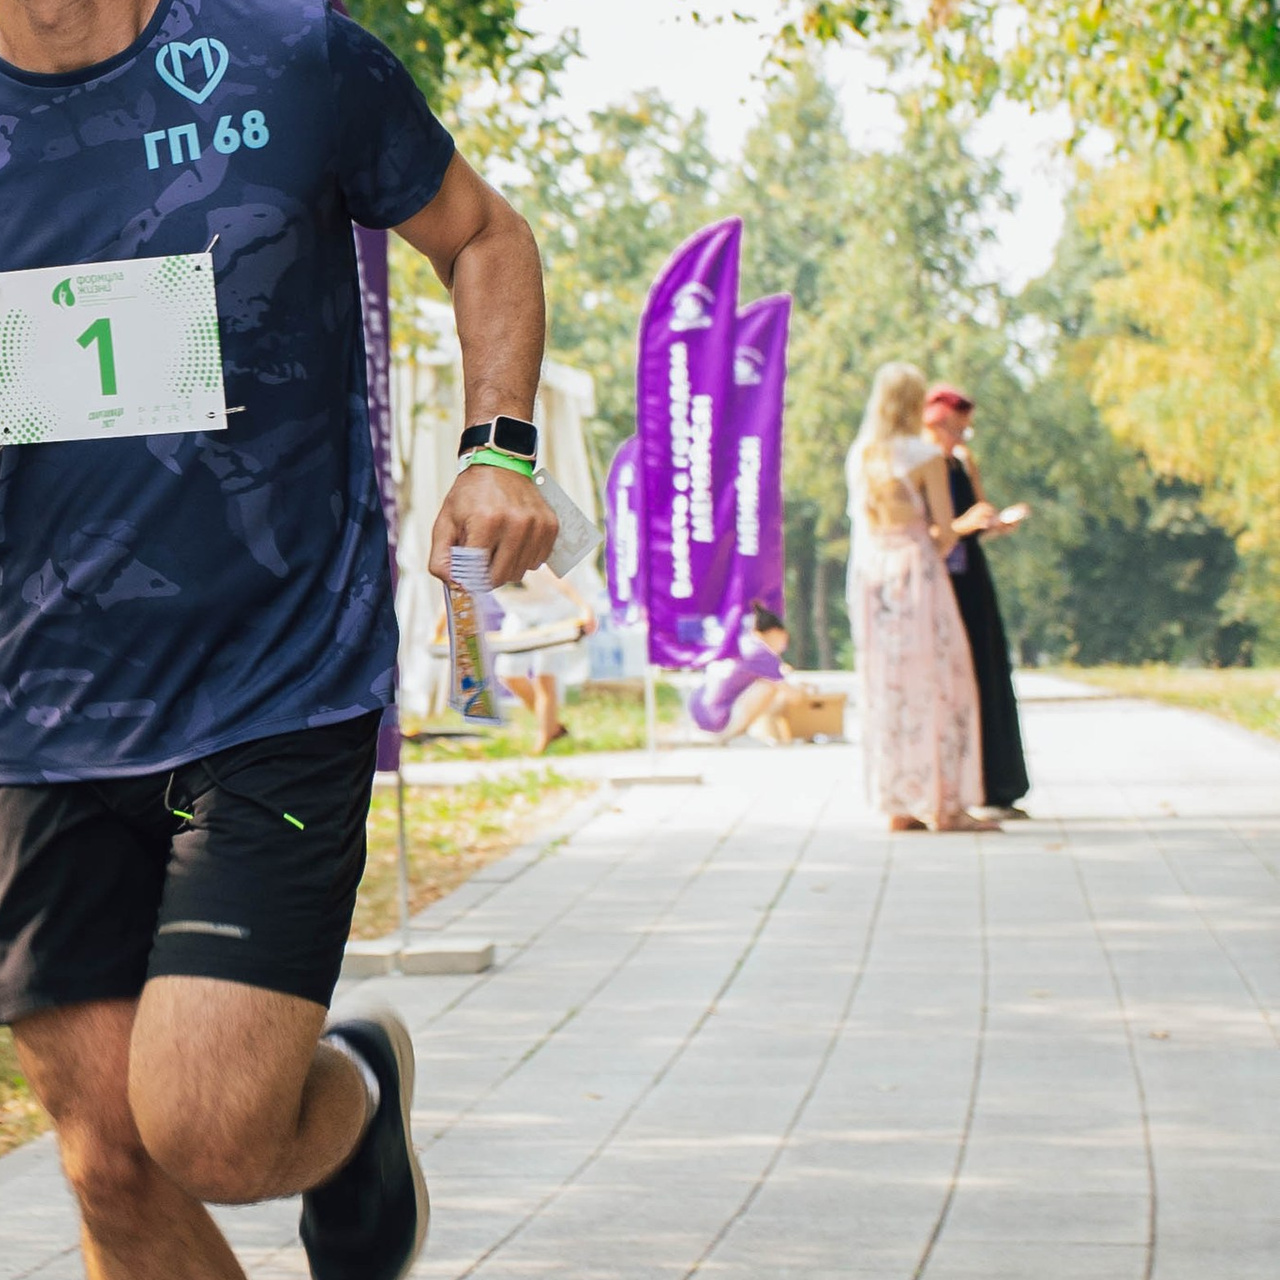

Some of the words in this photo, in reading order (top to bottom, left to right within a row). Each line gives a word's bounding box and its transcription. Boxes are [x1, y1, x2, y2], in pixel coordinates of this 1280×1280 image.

[143, 122, 202, 170] ГП
[213, 109, 270, 154] 68
[76, 318, 117, 395] 1
